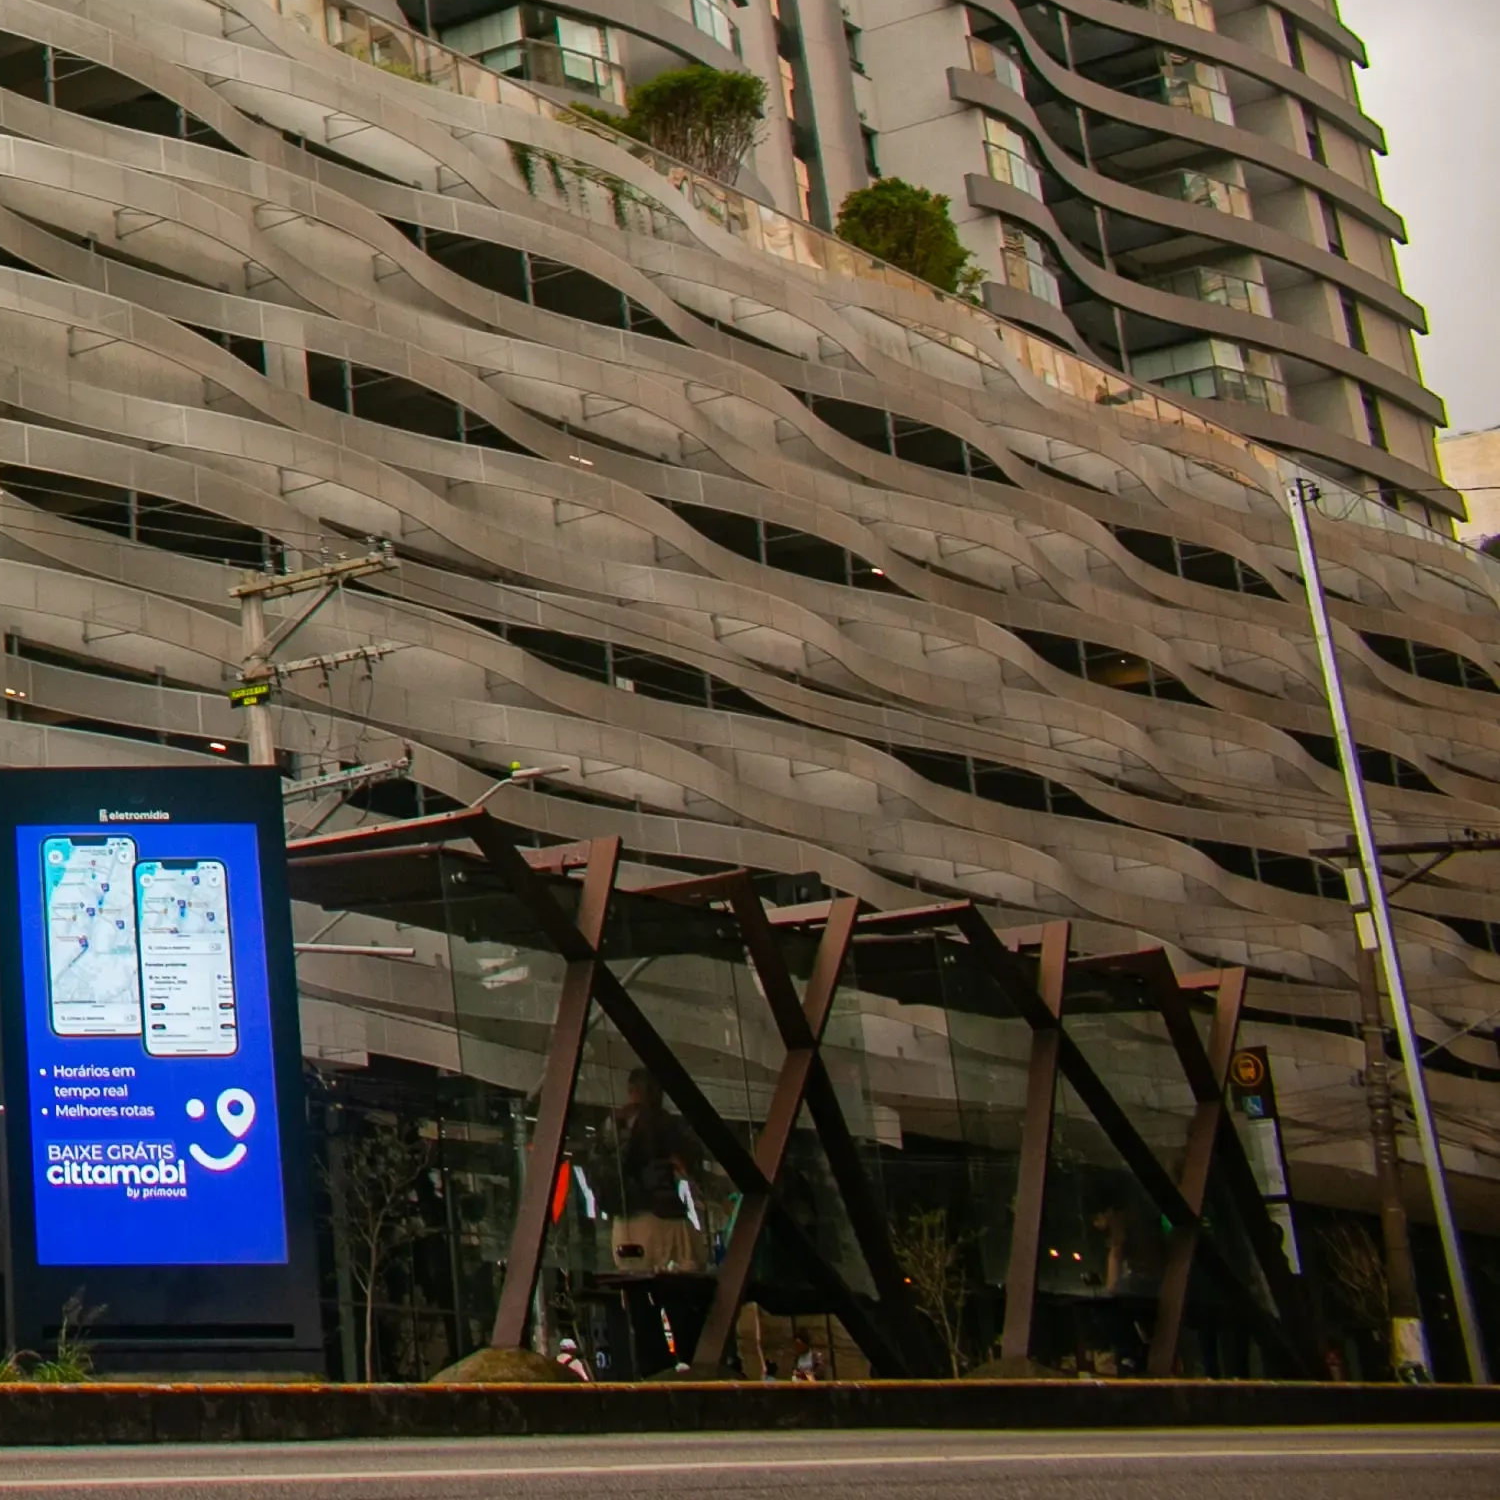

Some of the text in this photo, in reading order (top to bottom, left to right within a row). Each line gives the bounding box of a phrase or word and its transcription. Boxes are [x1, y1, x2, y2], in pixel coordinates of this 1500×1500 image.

[108, 810, 170, 820] eletromidia
[53, 1064, 135, 1078] Horários em
[54, 1084, 128, 1099] tempo real
[55, 1104, 155, 1117] Melhores rotas
[48, 1141, 174, 1161] BAIXE GRÁTIS
[46, 1159, 187, 1185] cittamobi
[126, 1186, 187, 1198] by primova
